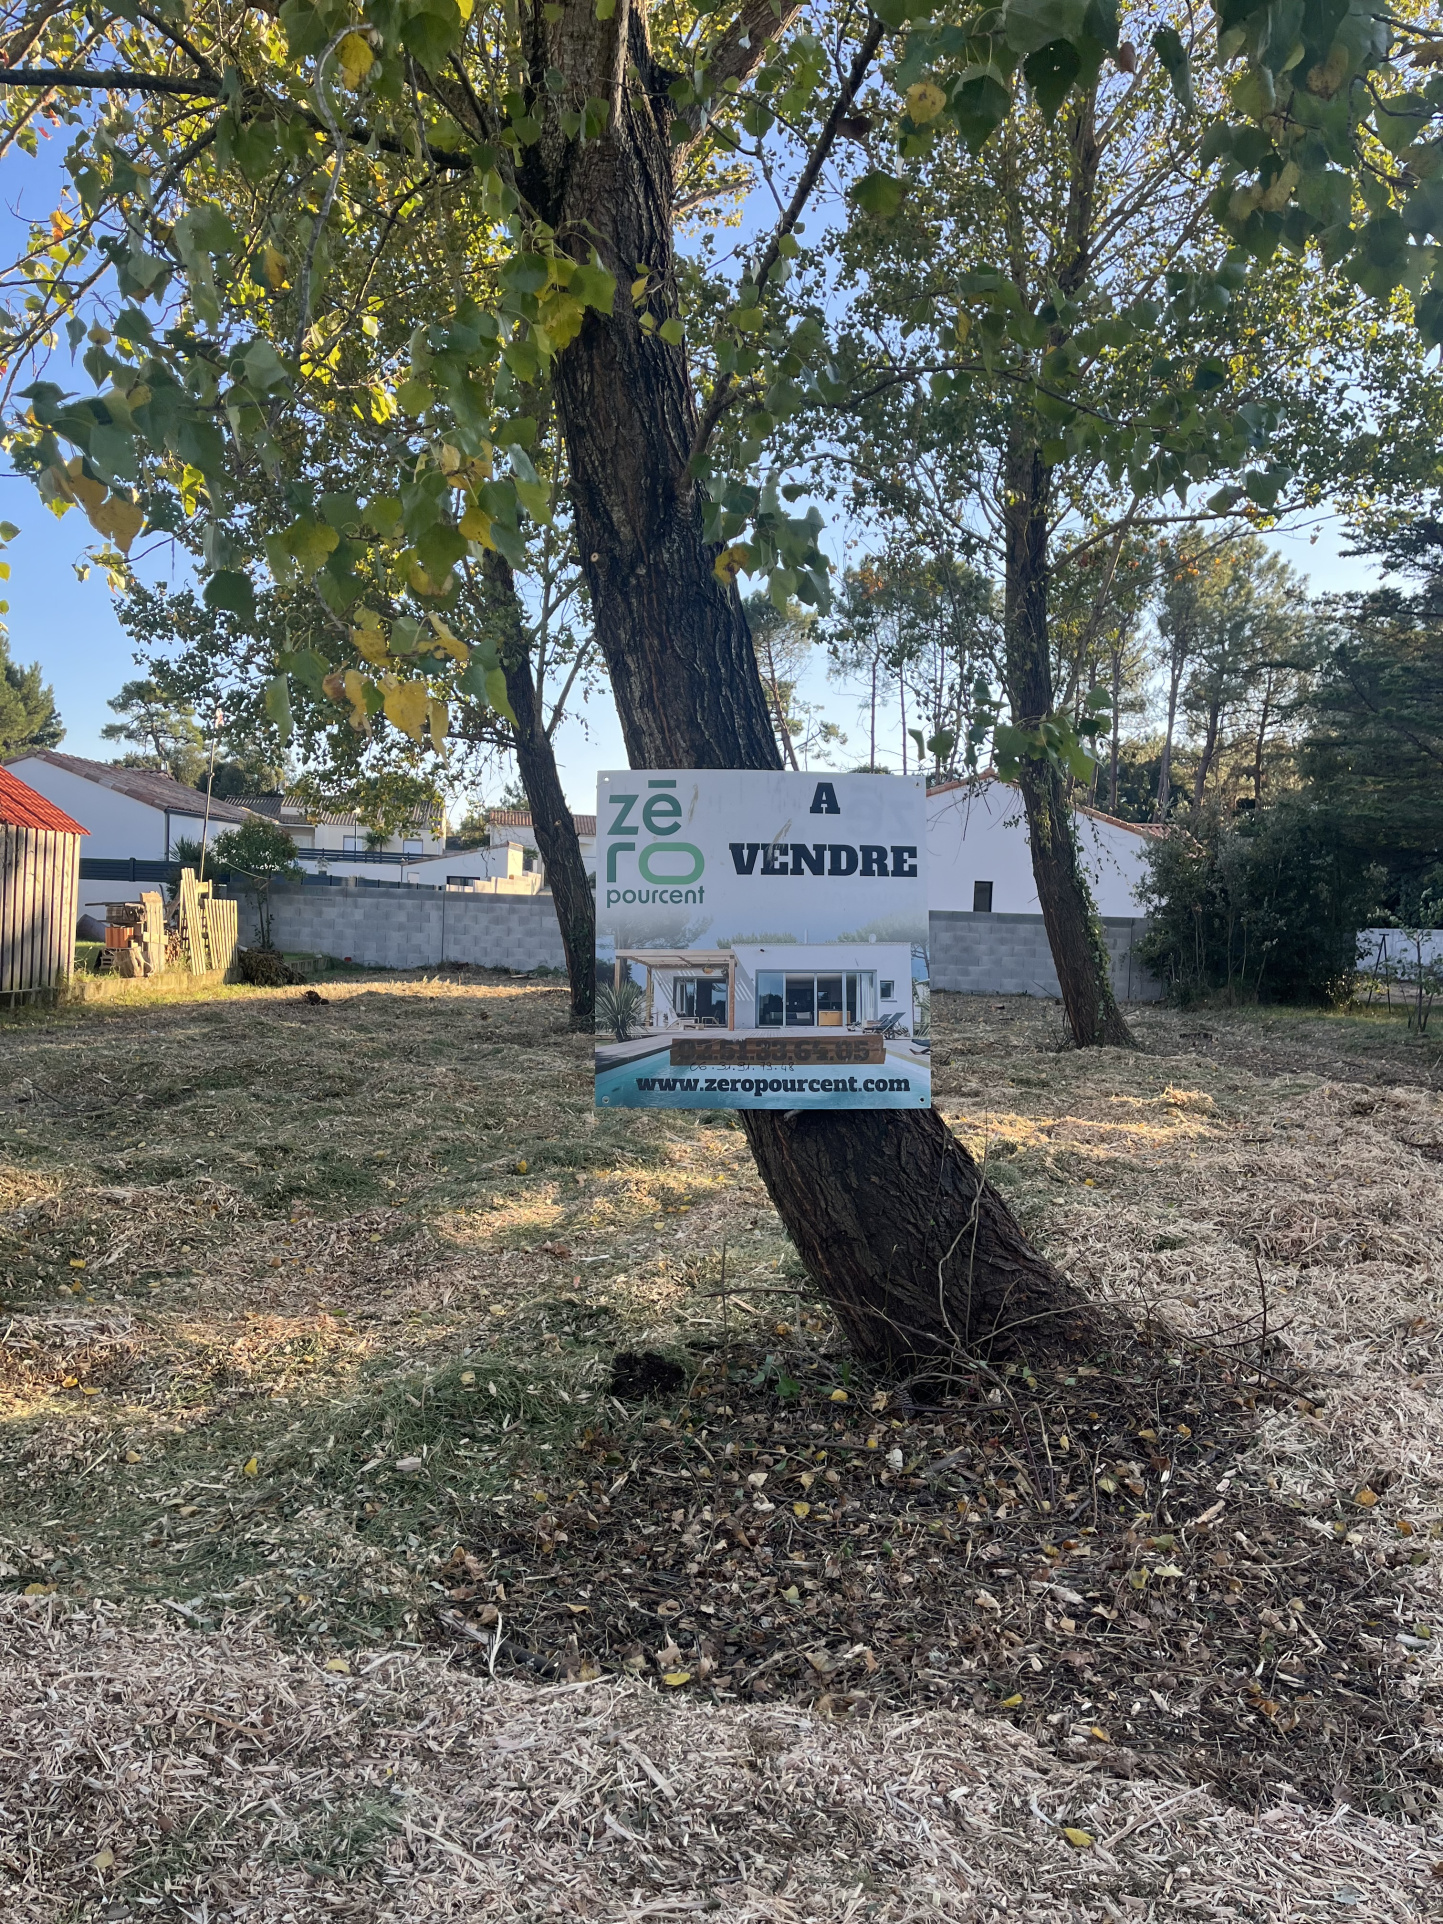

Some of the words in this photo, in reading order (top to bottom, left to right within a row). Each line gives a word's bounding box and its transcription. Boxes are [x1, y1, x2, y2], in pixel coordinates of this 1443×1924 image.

[810, 782, 840, 814] A
[729, 843, 918, 877] VENDRE
[606, 885, 705, 908] pourcent
[636, 1076, 911, 1096] www.zeropourcent.com
